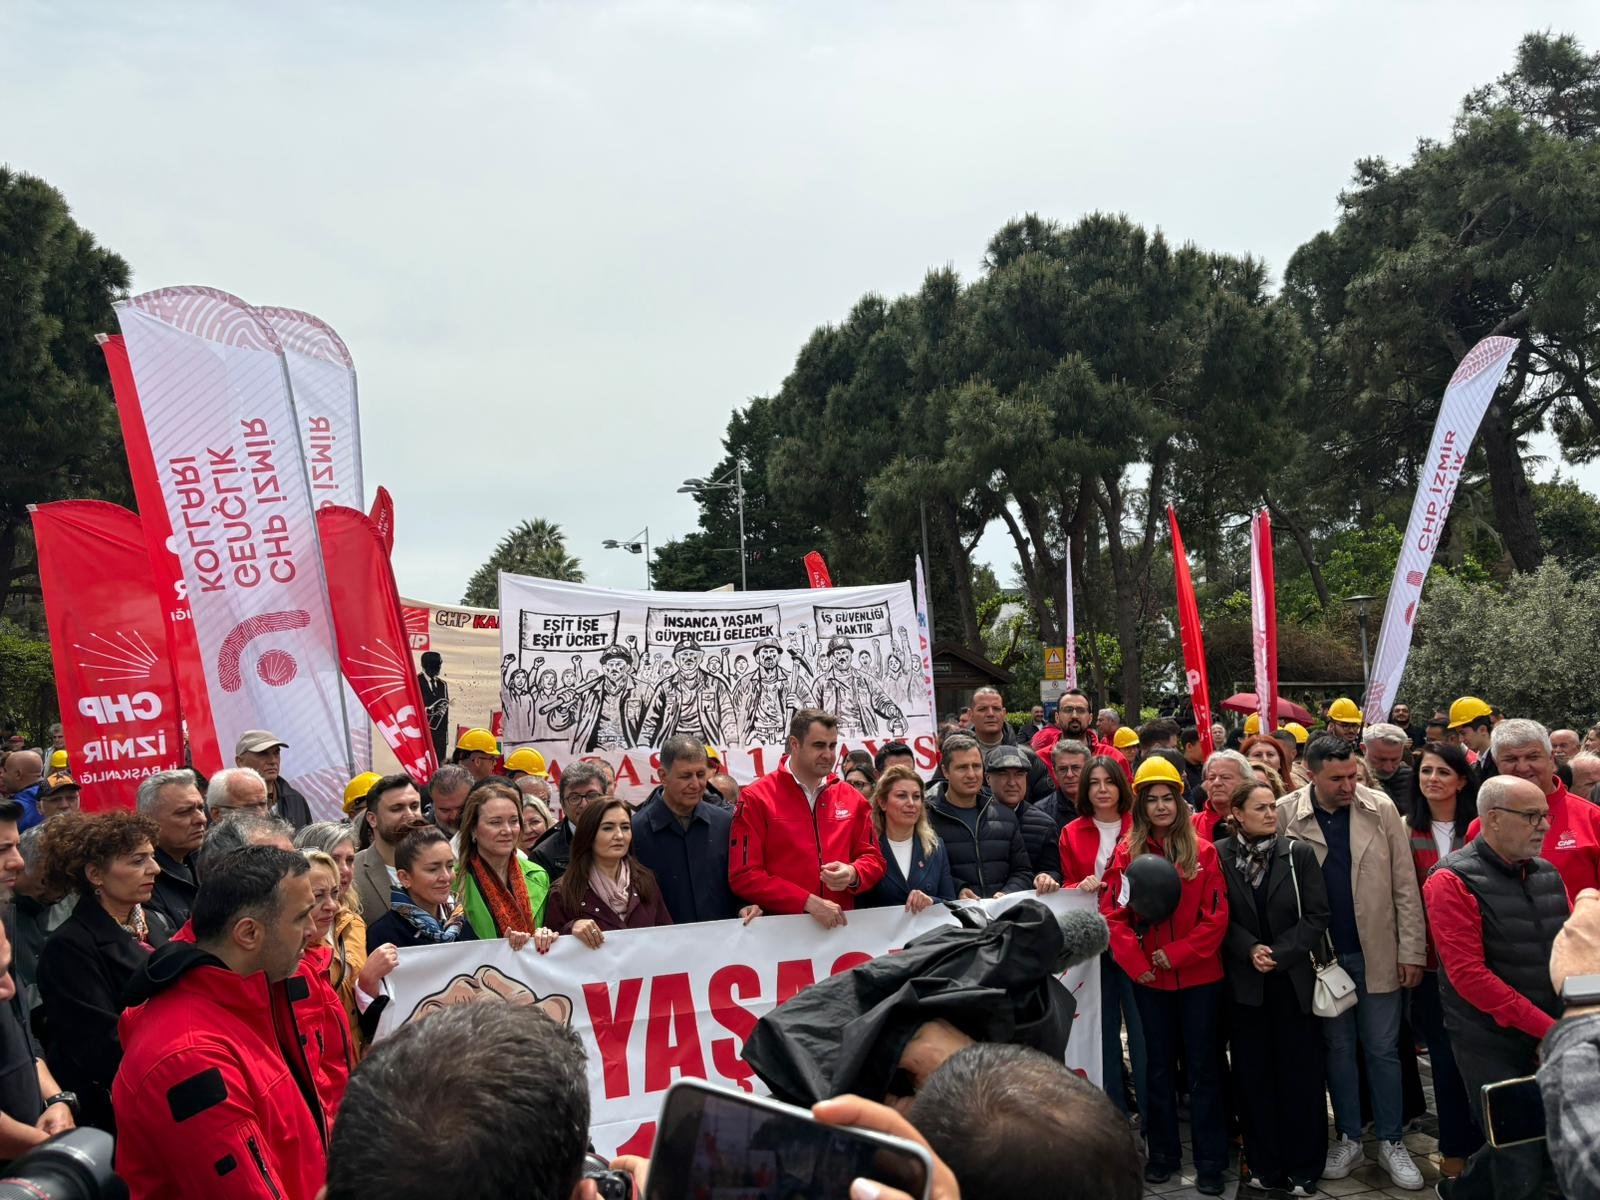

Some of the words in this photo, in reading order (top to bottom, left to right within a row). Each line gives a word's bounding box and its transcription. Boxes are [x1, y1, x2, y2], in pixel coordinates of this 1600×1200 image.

[1418, 501, 1437, 552] CHP
[1429, 430, 1456, 494] İZMİR
[436, 610, 471, 628] CHP
[473, 614, 500, 629] KA
[543, 617, 574, 633] EŞİT
[577, 617, 599, 633] İŞE
[664, 614, 718, 628] İNSANCA
[721, 613, 762, 627] YAŞAM
[821, 611, 832, 625] İŞ
[835, 608, 884, 623] GÜVENLİĞİ
[655, 628, 720, 642] GÜVENCELİ
[724, 625, 773, 640] GELECEK
[836, 623, 873, 635] HAKTIR
[533, 632, 563, 649] EŞİT
[566, 632, 608, 647] ÜCRET
[747, 747, 765, 778] 1
